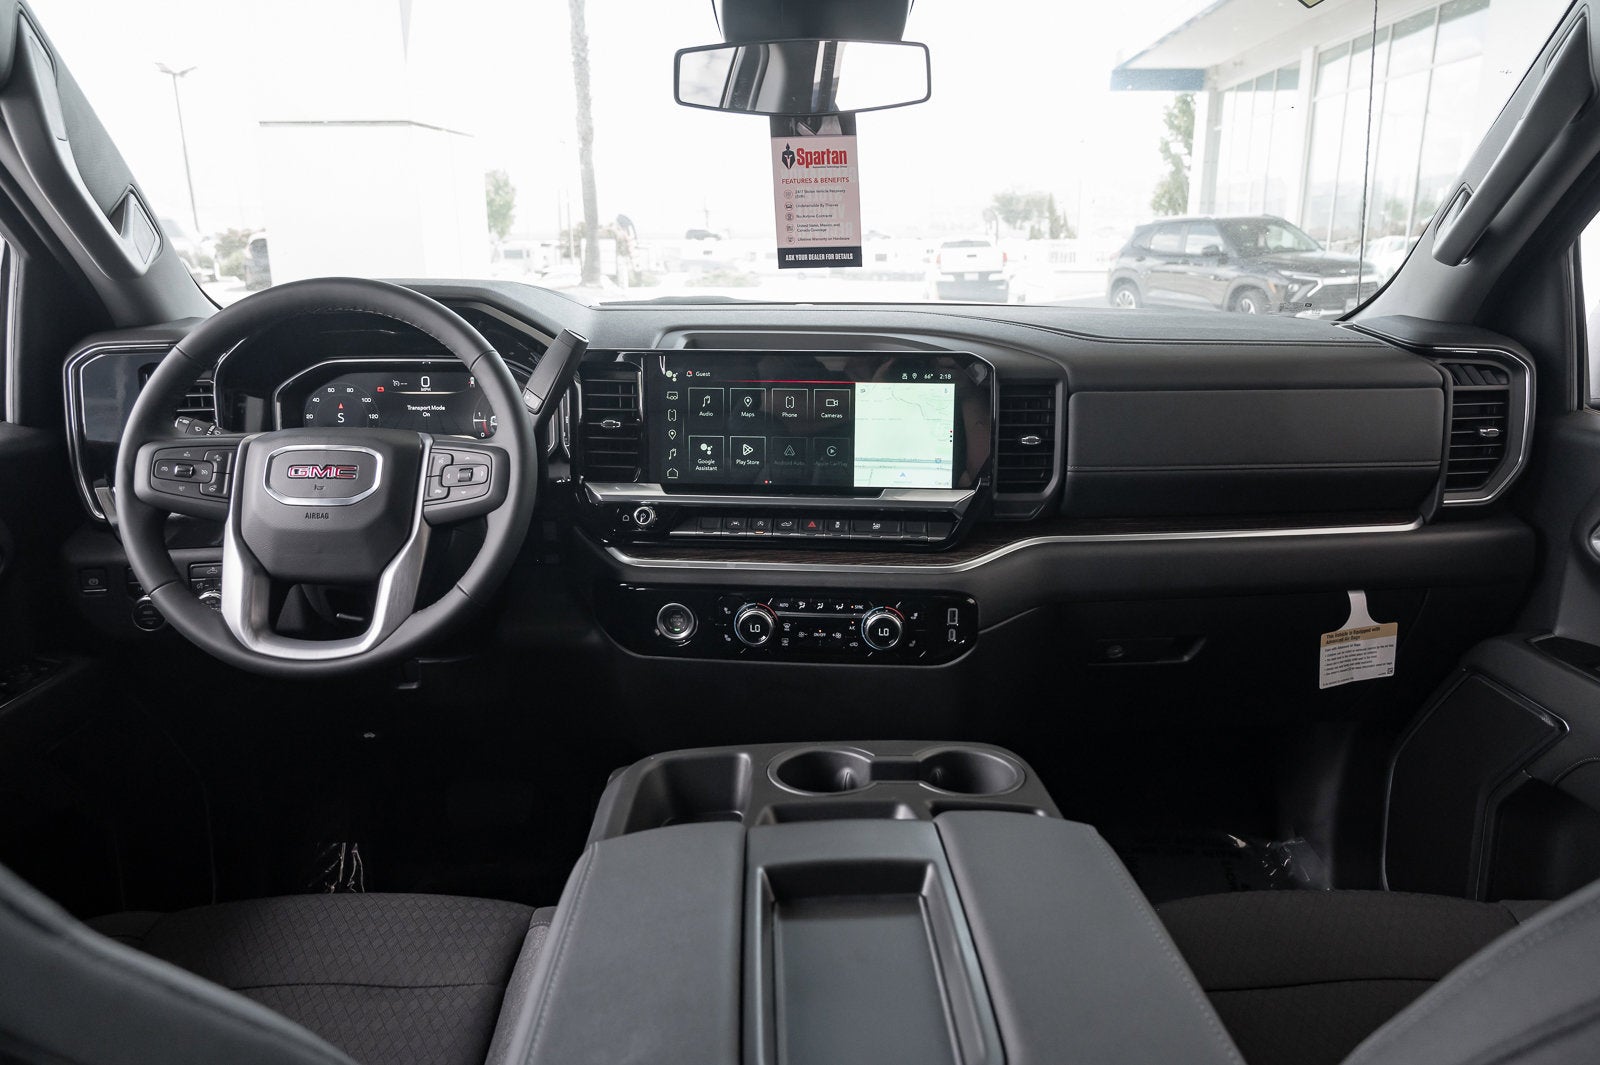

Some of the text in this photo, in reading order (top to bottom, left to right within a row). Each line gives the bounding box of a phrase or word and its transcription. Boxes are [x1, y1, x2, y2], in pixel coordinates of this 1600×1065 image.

[796, 148, 848, 168] Spartan
[421, 376, 430, 387] 0
[337, 412, 344, 423] S
[288, 464, 359, 479] GMC
[750, 625, 761, 633] LO
